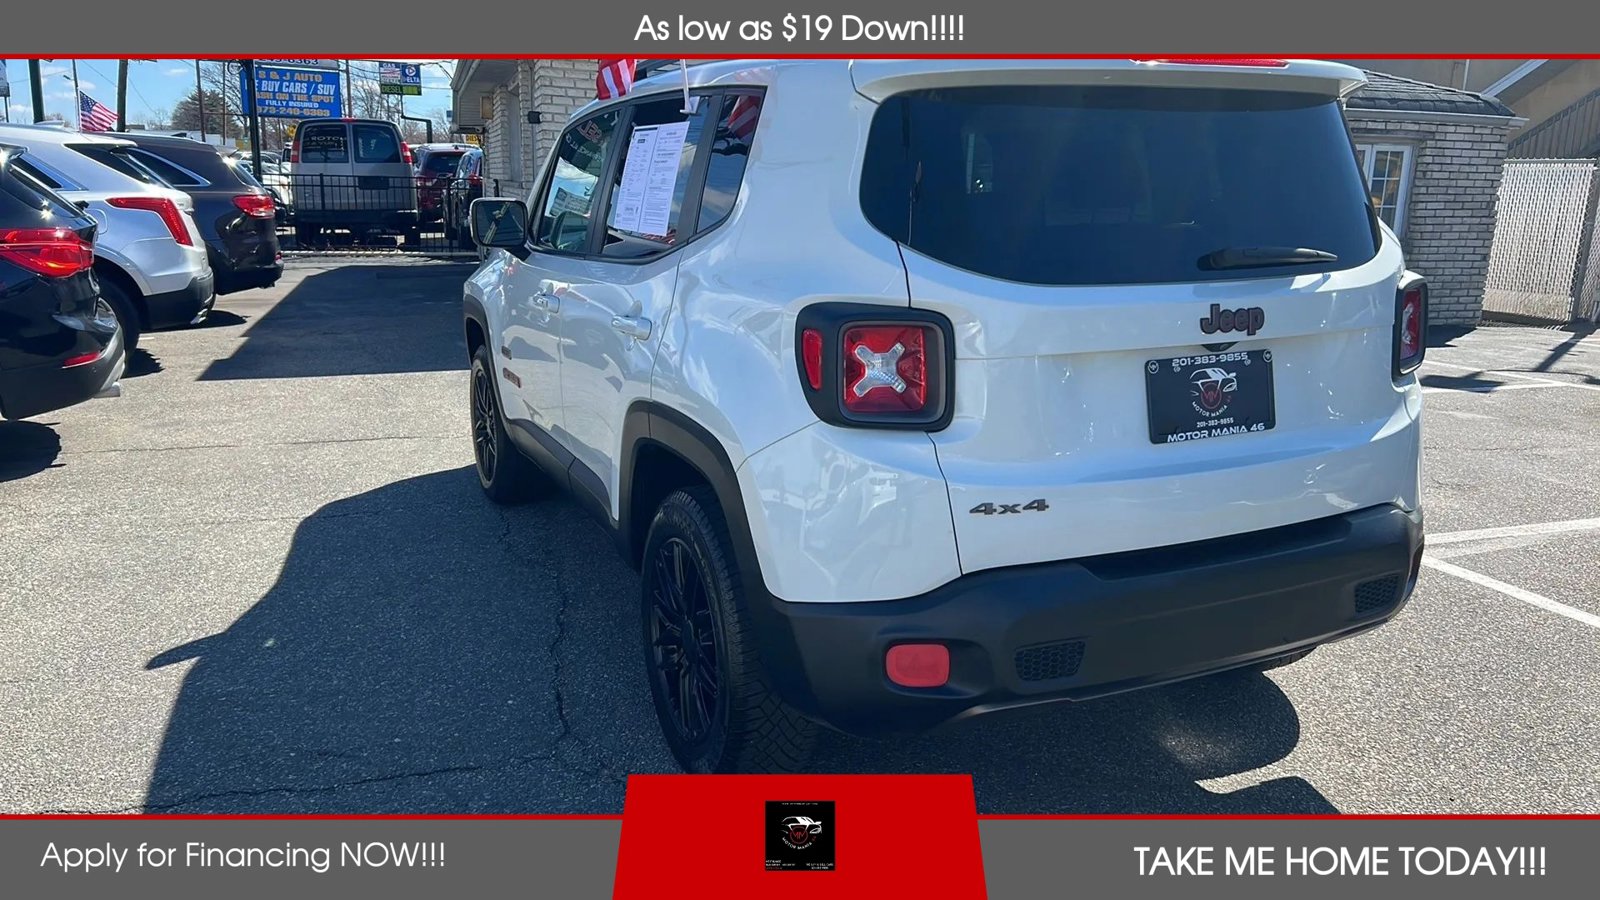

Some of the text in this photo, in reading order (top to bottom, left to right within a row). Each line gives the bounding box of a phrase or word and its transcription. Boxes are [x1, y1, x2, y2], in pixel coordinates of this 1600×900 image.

[294, 73, 323, 82] AUTO
[261, 80, 281, 92] BUY
[282, 82, 308, 94] CARS
[317, 84, 336, 95] SUV
[292, 93, 309, 102] THE
[311, 95, 335, 103] SPOT
[1200, 303, 1265, 336] Jeep
[1172, 352, 1249, 367] 201-383-9855
[1191, 401, 1228, 417] MOTOR MANIA
[1196, 417, 1235, 428] 201-383-9855
[1167, 422, 1265, 443] MOTOR MANIA 46
[969, 498, 1050, 515] 4x4
